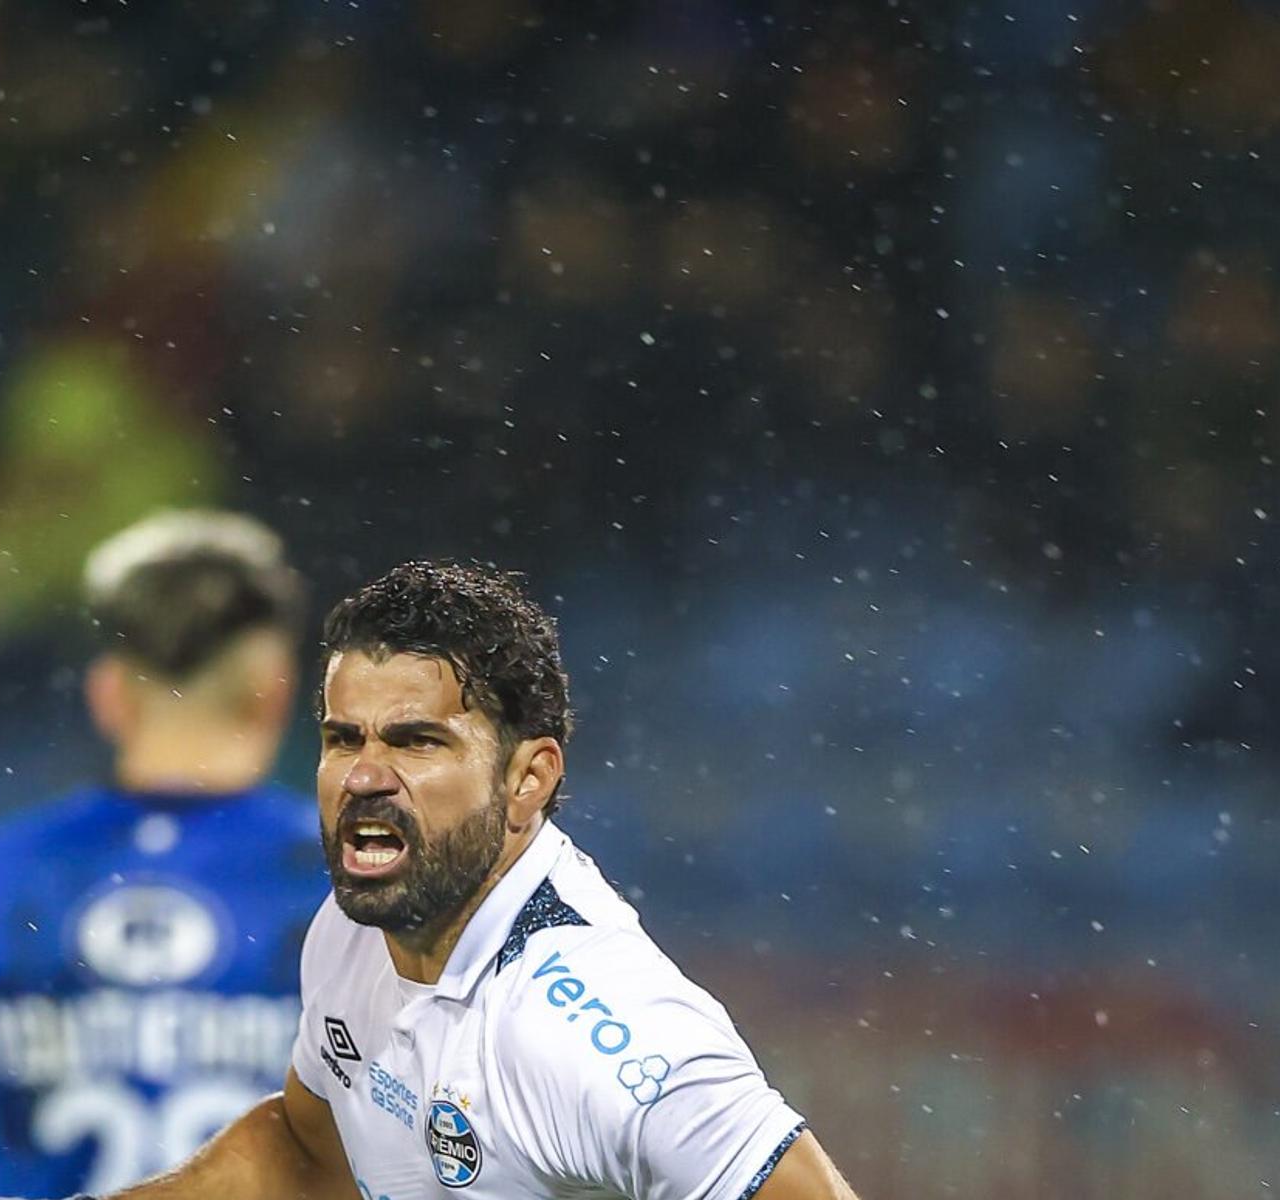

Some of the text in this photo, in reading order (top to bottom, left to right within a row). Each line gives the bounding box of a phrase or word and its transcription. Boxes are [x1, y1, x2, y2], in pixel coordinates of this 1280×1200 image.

[531, 951, 632, 1056] vero
[368, 1060, 419, 1111] Esportes
[428, 1131, 477, 1163] RÊMIO
